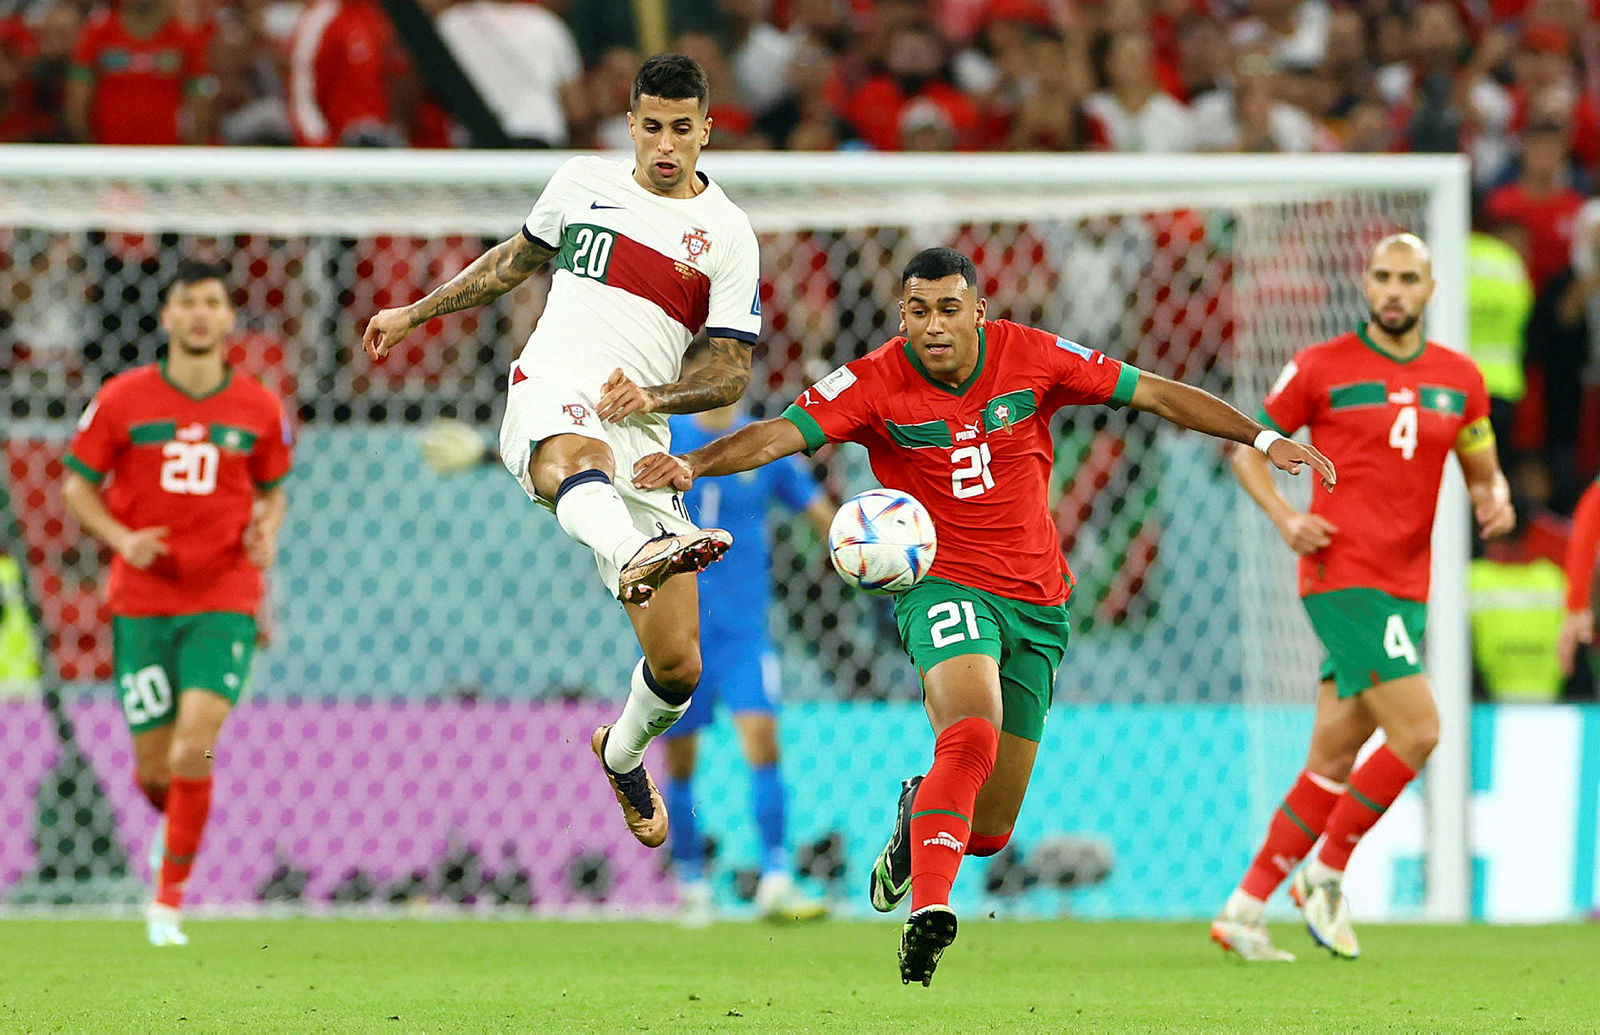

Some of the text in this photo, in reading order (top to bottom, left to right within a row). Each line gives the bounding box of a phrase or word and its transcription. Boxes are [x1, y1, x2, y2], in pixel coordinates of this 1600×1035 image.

[572, 228, 613, 278] 20
[1388, 406, 1418, 460] 4
[160, 441, 219, 495] 20
[950, 442, 996, 499] 21
[927, 600, 980, 648] 21
[1383, 613, 1418, 665] 4
[121, 664, 172, 724] 20
